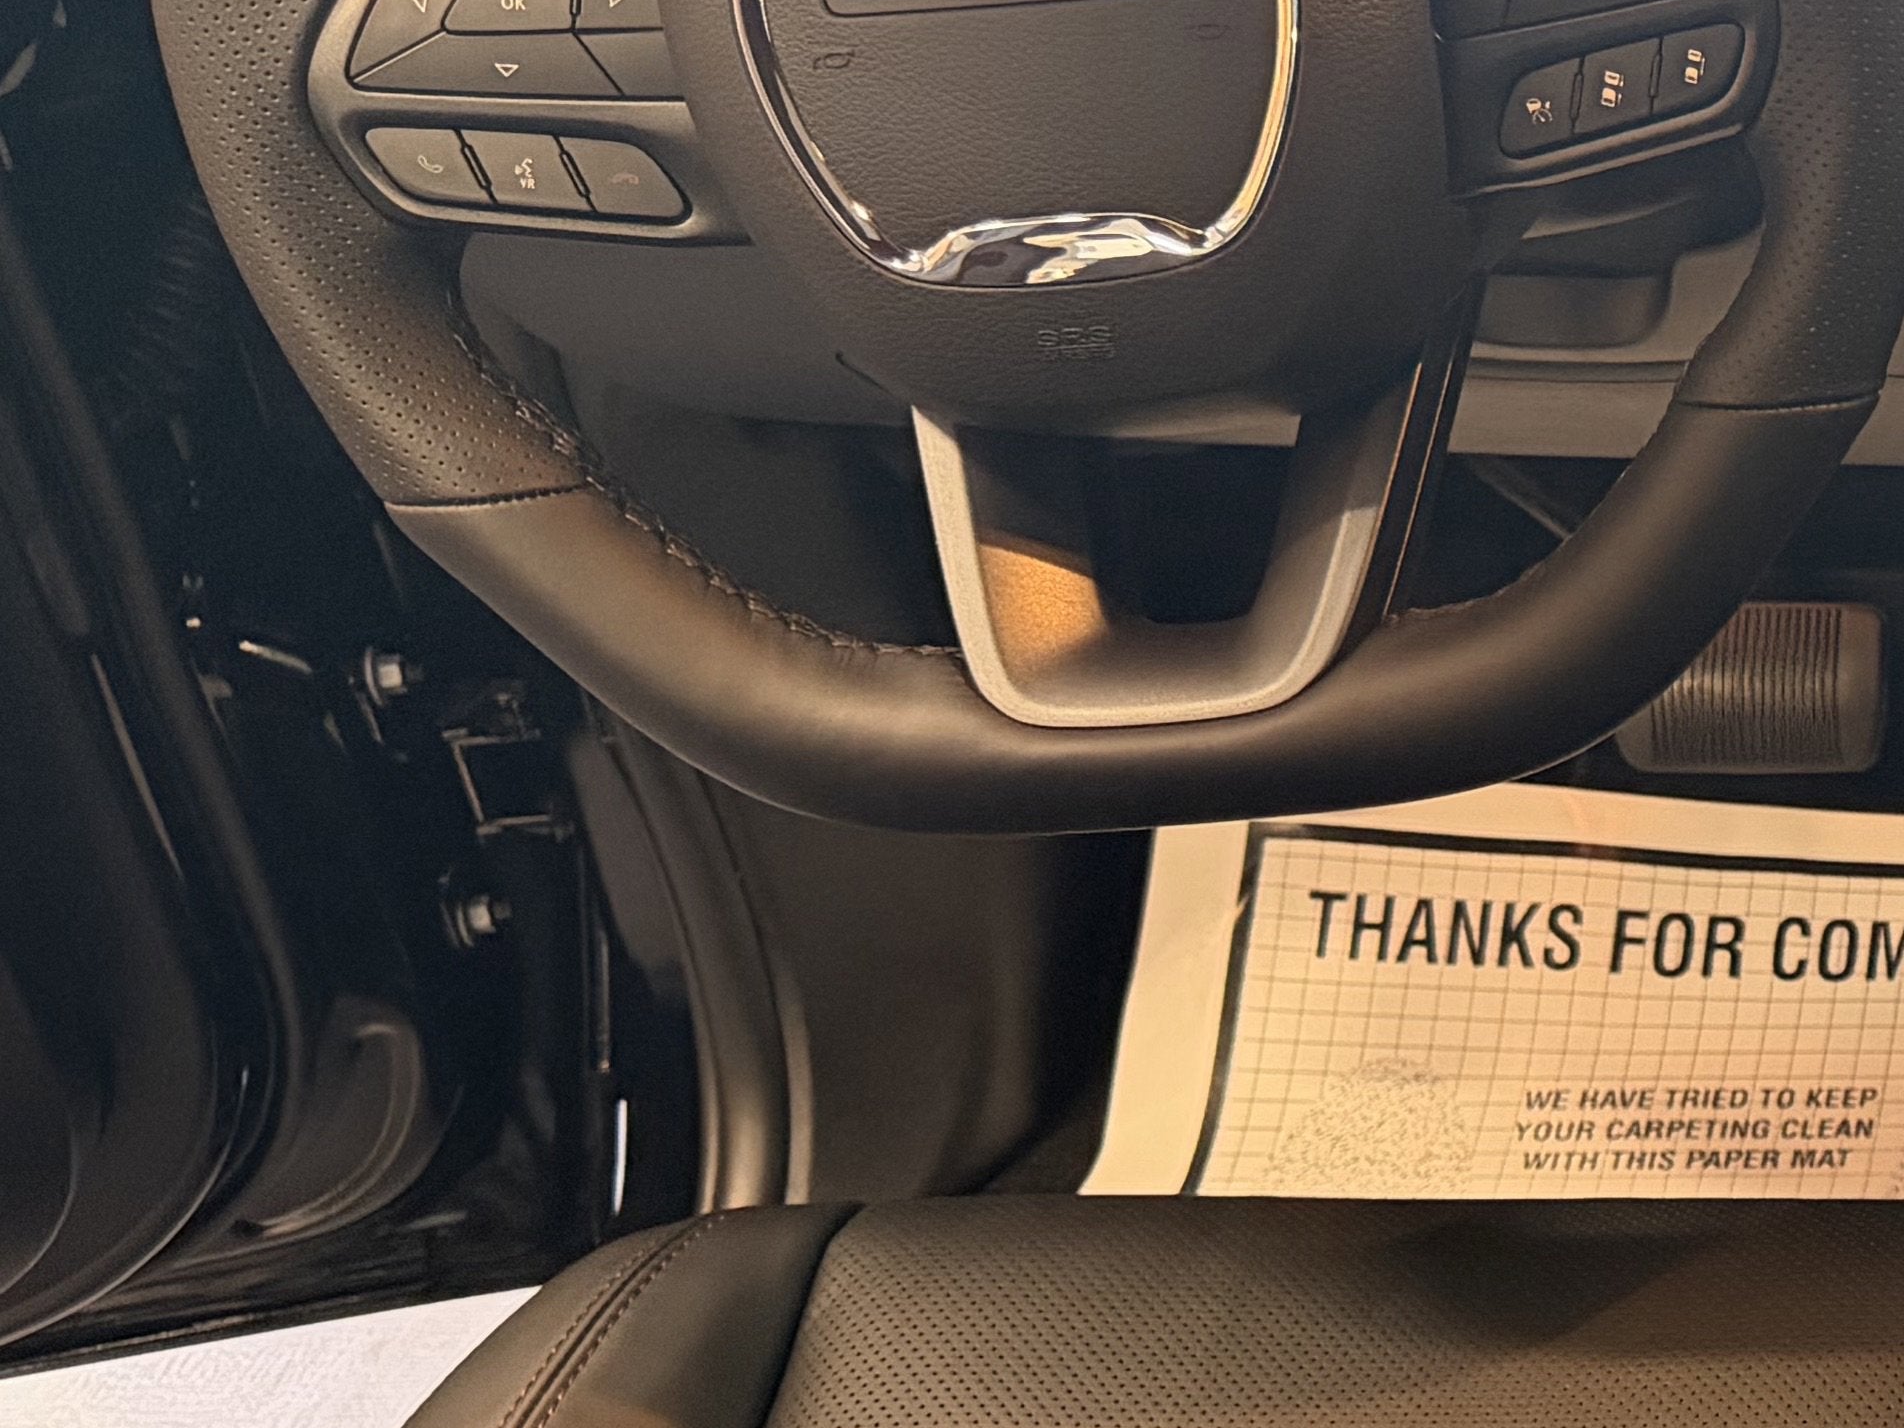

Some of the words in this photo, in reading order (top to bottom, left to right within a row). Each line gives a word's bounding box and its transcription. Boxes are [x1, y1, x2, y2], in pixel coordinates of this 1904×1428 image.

[519, 176, 536, 190] VR
[1306, 889, 1585, 976] THANKS
[1609, 909, 1746, 984] FOR
[1524, 1087, 1571, 1113] WE
[1578, 1087, 1655, 1113] HAVE
[1663, 1087, 1751, 1113] TRIED
[1759, 1087, 1798, 1113] TO
[1805, 1087, 1881, 1113] KEEP
[1514, 1117, 1596, 1144] YOUR
[1603, 1117, 1776, 1144] CARPETING
[1782, 1117, 1876, 1144] CLEAN
[1521, 1147, 1599, 1173] WITH
[1606, 1147, 1679, 1173] THIS
[1686, 1147, 1781, 1173] PAPER
[1788, 1147, 1854, 1172] MAT
